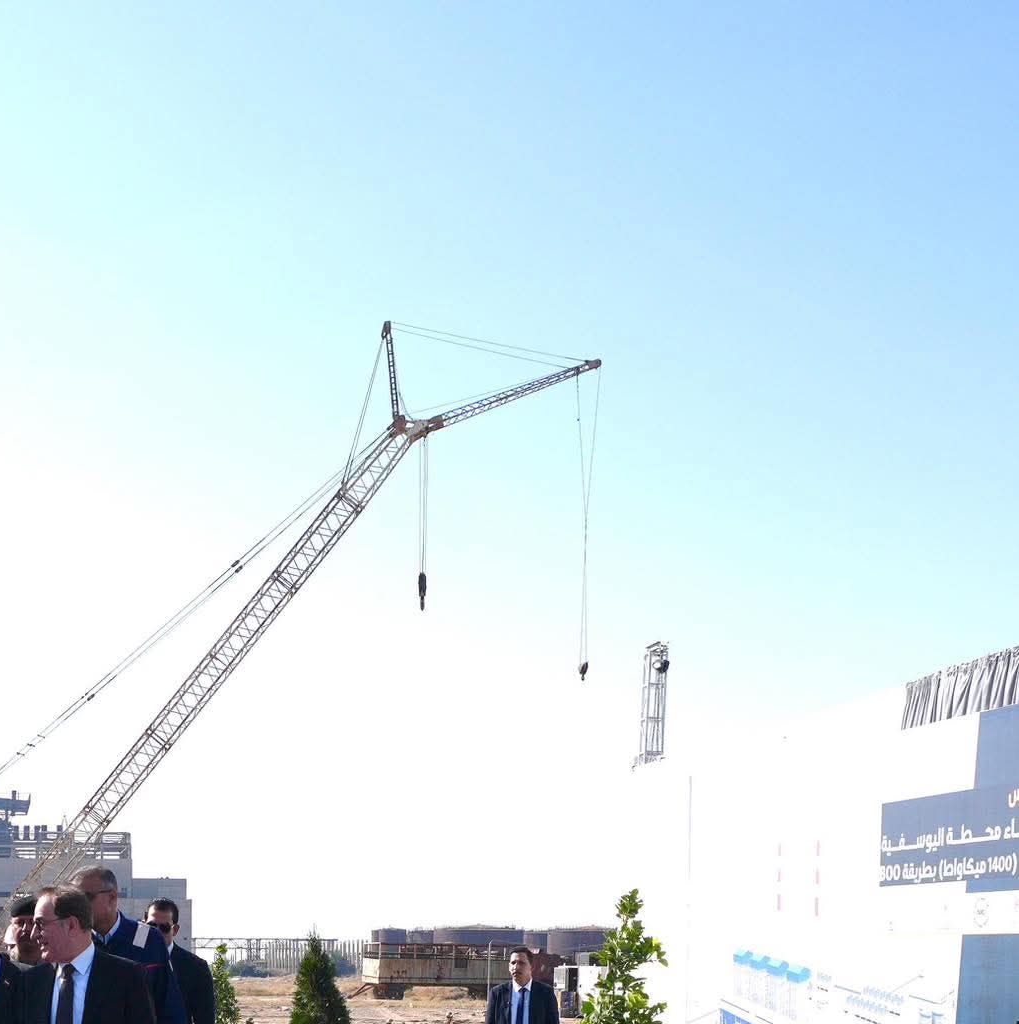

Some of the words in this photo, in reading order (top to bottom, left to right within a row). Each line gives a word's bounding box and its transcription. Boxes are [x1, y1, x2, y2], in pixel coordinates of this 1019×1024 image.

[946, 824, 1002, 846] محطة
[1003, 817, 1019, 840] اء
[882, 826, 945, 856] اليوسفية
[902, 861, 937, 883] بطريقة
[988, 852, 1017, 876] (1400
